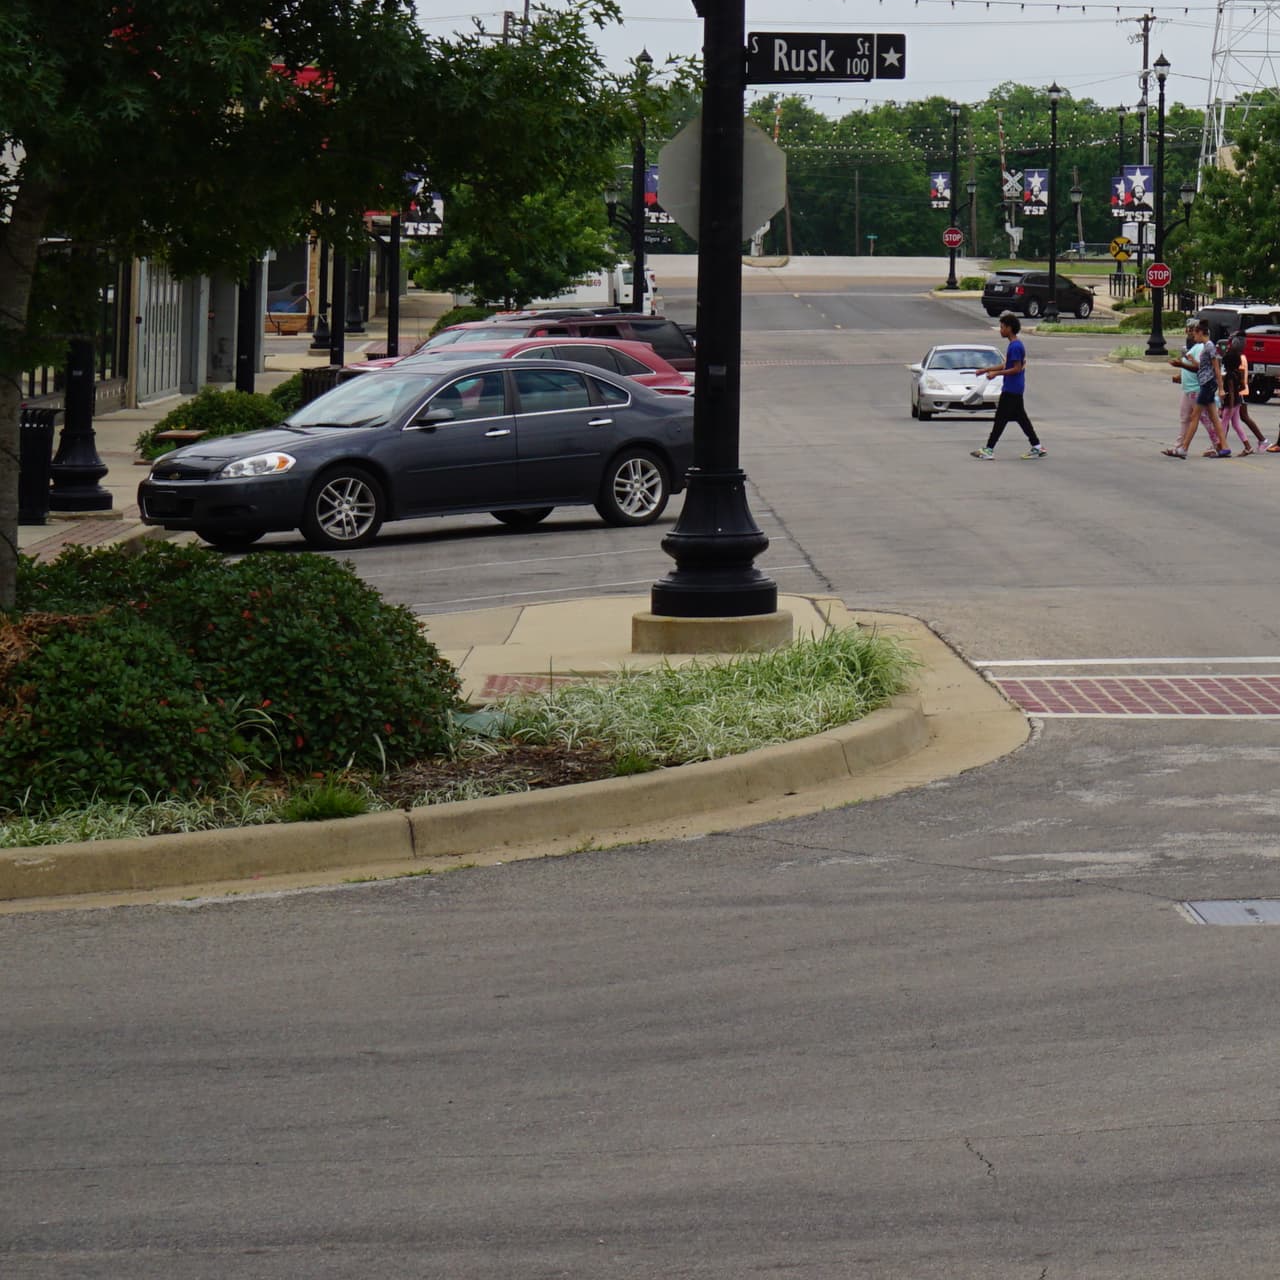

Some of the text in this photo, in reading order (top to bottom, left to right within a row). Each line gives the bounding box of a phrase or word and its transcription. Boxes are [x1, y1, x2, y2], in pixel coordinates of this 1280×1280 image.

[752, 36, 870, 72] S Rusk St
[847, 57, 870, 75] 100
[931, 200, 950, 208] TSF
[1023, 206, 1048, 215] TSF
[1112, 208, 1125, 217] TS
[1125, 210, 1153, 222] TSF
[404, 222, 443, 236] TSF
[944, 234, 962, 242] STOP
[1148, 270, 1169, 281] STOP
